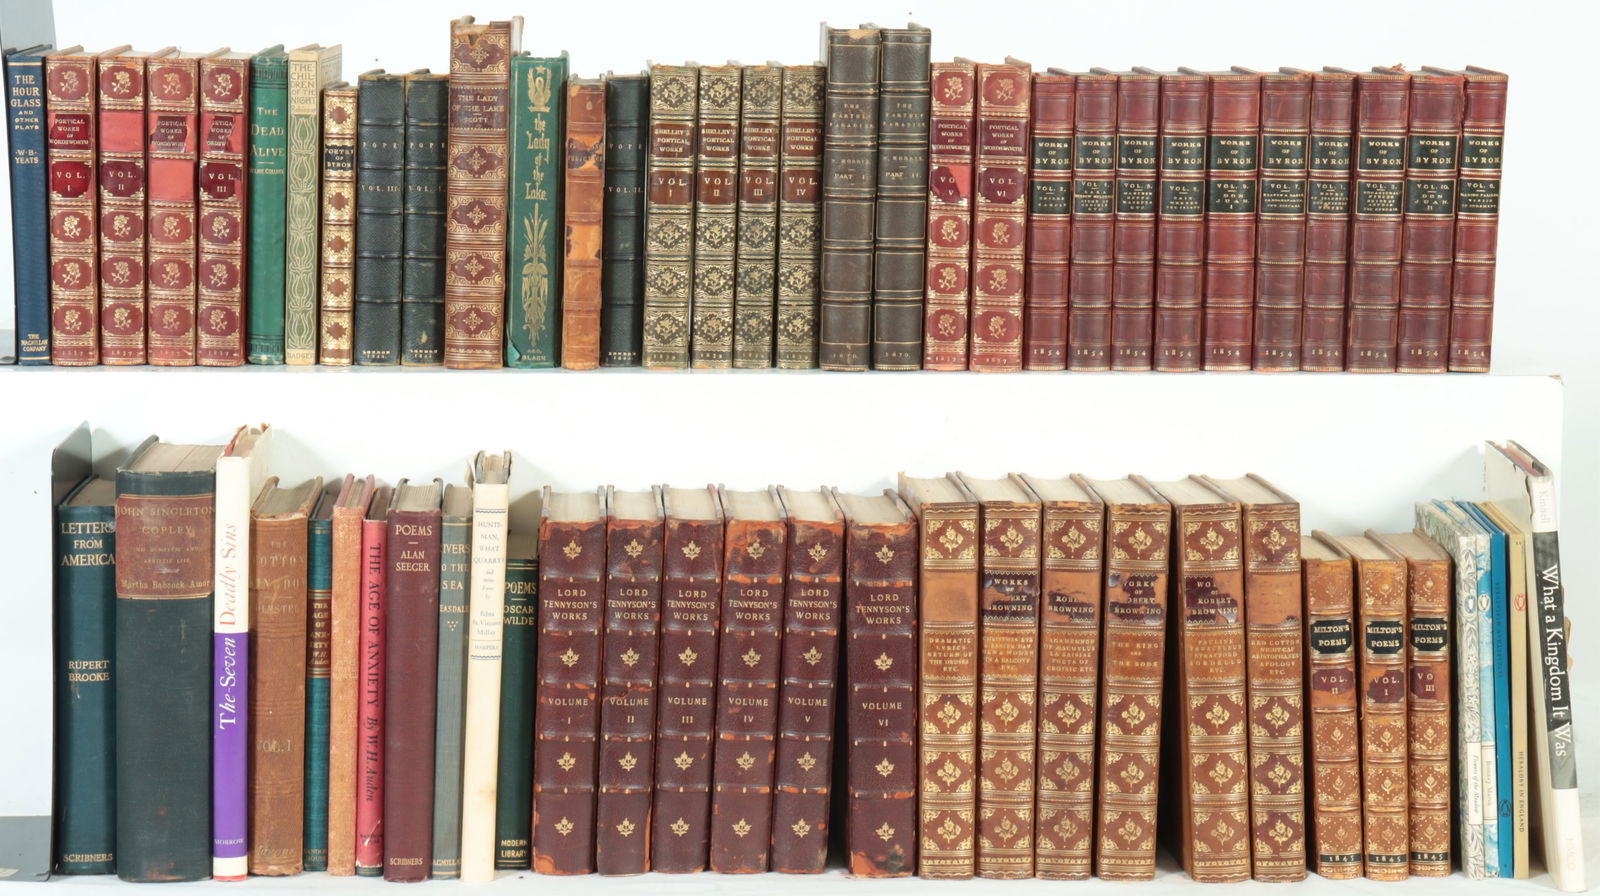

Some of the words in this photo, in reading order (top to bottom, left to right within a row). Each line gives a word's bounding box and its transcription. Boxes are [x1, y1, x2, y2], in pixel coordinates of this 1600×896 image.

[292, 63, 313, 72] THE
[15, 75, 35, 86] THE
[12, 87, 41, 98] HOUR
[10, 98, 42, 108] GLASS
[477, 95, 498, 103] LADY
[256, 106, 278, 116] THE
[251, 123, 285, 137] DEAD
[743, 126, 779, 135] SHELLEY'S
[786, 126, 822, 135] SHELLEY'S
[938, 122, 968, 130] POETICAL
[989, 124, 1020, 132] POETICAL
[654, 128, 690, 137] SHELLEY'S
[701, 128, 737, 136] SHELLEY'S
[362, 142, 398, 150] POPE
[526, 131, 550, 160] Lady
[1123, 139, 1154, 147] WORKS
[251, 143, 285, 158] ALIVE
[15, 156, 39, 165] YEATS
[534, 153, 544, 166] of
[56, 171, 86, 180] VOL.
[109, 170, 137, 179] VOL.
[658, 178, 688, 187] VOL.
[703, 177, 733, 186] VOL.
[745, 176, 775, 185] VOL.
[788, 176, 819, 185] VOL.
[990, 176, 1017, 185] VOL.
[996, 190, 1007, 198] VI
[150, 506, 215, 517] SINGLETON
[61, 521, 117, 535] LETTERS
[395, 524, 433, 538] POEMS
[73, 539, 104, 549] FROM
[220, 523, 238, 560] Sins
[479, 545, 500, 553] WHAT
[369, 543, 382, 575] THE
[400, 550, 425, 560] ALAN
[61, 554, 117, 566] AMERICA
[395, 561, 431, 572] SEEGER
[442, 579, 464, 591] SEA
[994, 578, 1029, 586] WORKS
[505, 581, 537, 594] POEMS
[1541, 563, 1561, 611] What
[219, 566, 241, 627] Deadly
[368, 580, 382, 611] AGE
[558, 589, 587, 597] LORD
[620, 588, 649, 597] LORD
[678, 589, 708, 599] LORD
[740, 589, 769, 598] LORD
[801, 589, 831, 598] LORD
[870, 593, 900, 602] LORD
[1197, 597, 1232, 605] ROBERT
[543, 599, 599, 609] TENNYSON'S
[608, 599, 657, 609] TENNYSON'S
[666, 600, 716, 610] TENNYSON'S
[728, 599, 779, 610] TENNYSON'S
[789, 599, 839, 609] TENNYSON'S
[991, 604, 1033, 612] ROWNING
[1048, 604, 1094, 613] BROWNING
[503, 604, 535, 614] OSCAR
[855, 605, 911, 615] TENNYSON'S
[552, 611, 589, 621] WORKS
[614, 611, 650, 620] WORKS
[673, 612, 710, 621] WORKS
[735, 611, 771, 621] WORKS
[796, 611, 832, 621] WORKS
[1545, 614, 1557, 624] a
[503, 616, 535, 627] WILDE
[866, 616, 902, 625] WORKS
[368, 615, 381, 636] OF
[1313, 624, 1350, 634] MILTON'S
[1366, 625, 1403, 634] MILTON'S
[1411, 623, 1448, 631] MILTON'S
[477, 628, 497, 639] Millay
[929, 637, 972, 645] DRAMATIC
[1318, 638, 1347, 647] POEMS
[1371, 640, 1401, 648] POEMS
[1414, 636, 1444, 645] POEMS
[68, 660, 110, 670] RUPERT
[219, 637, 237, 688] Seven
[1545, 626, 1568, 702] Kingdom
[68, 672, 110, 682] BROOKE
[366, 639, 381, 708] ANXIETY
[1320, 675, 1348, 684] VOL.
[1373, 676, 1401, 685] VOL.
[1384, 688, 1389, 697] I
[1425, 685, 1436, 693] III
[548, 697, 590, 706] VOLUME
[610, 697, 650, 706] VOLUME
[667, 697, 708, 706] VOLUME
[728, 697, 769, 706] VOLUME
[788, 697, 829, 707] VOLUME
[862, 702, 903, 711] VOLUME
[219, 696, 237, 731] The
[1552, 704, 1570, 719] It
[567, 716, 571, 724] I
[627, 715, 635, 724] II
[681, 716, 694, 724] III
[743, 715, 755, 724] IV
[804, 715, 812, 724] V
[878, 719, 889, 727] VI
[1554, 721, 1572, 758] Was
[1519, 789, 1525, 797] IN
[214, 838, 244, 847] MORROW
[501, 839, 529, 849] MODERN
[63, 853, 113, 864] SCRIBNERS
[501, 849, 528, 859] LIBRARY
[1329, 854, 1355, 863] 1845
[1417, 852, 1444, 861] 1845
[390, 857, 424, 867] SCRIBNERS
[1375, 855, 1402, 864] 1845
